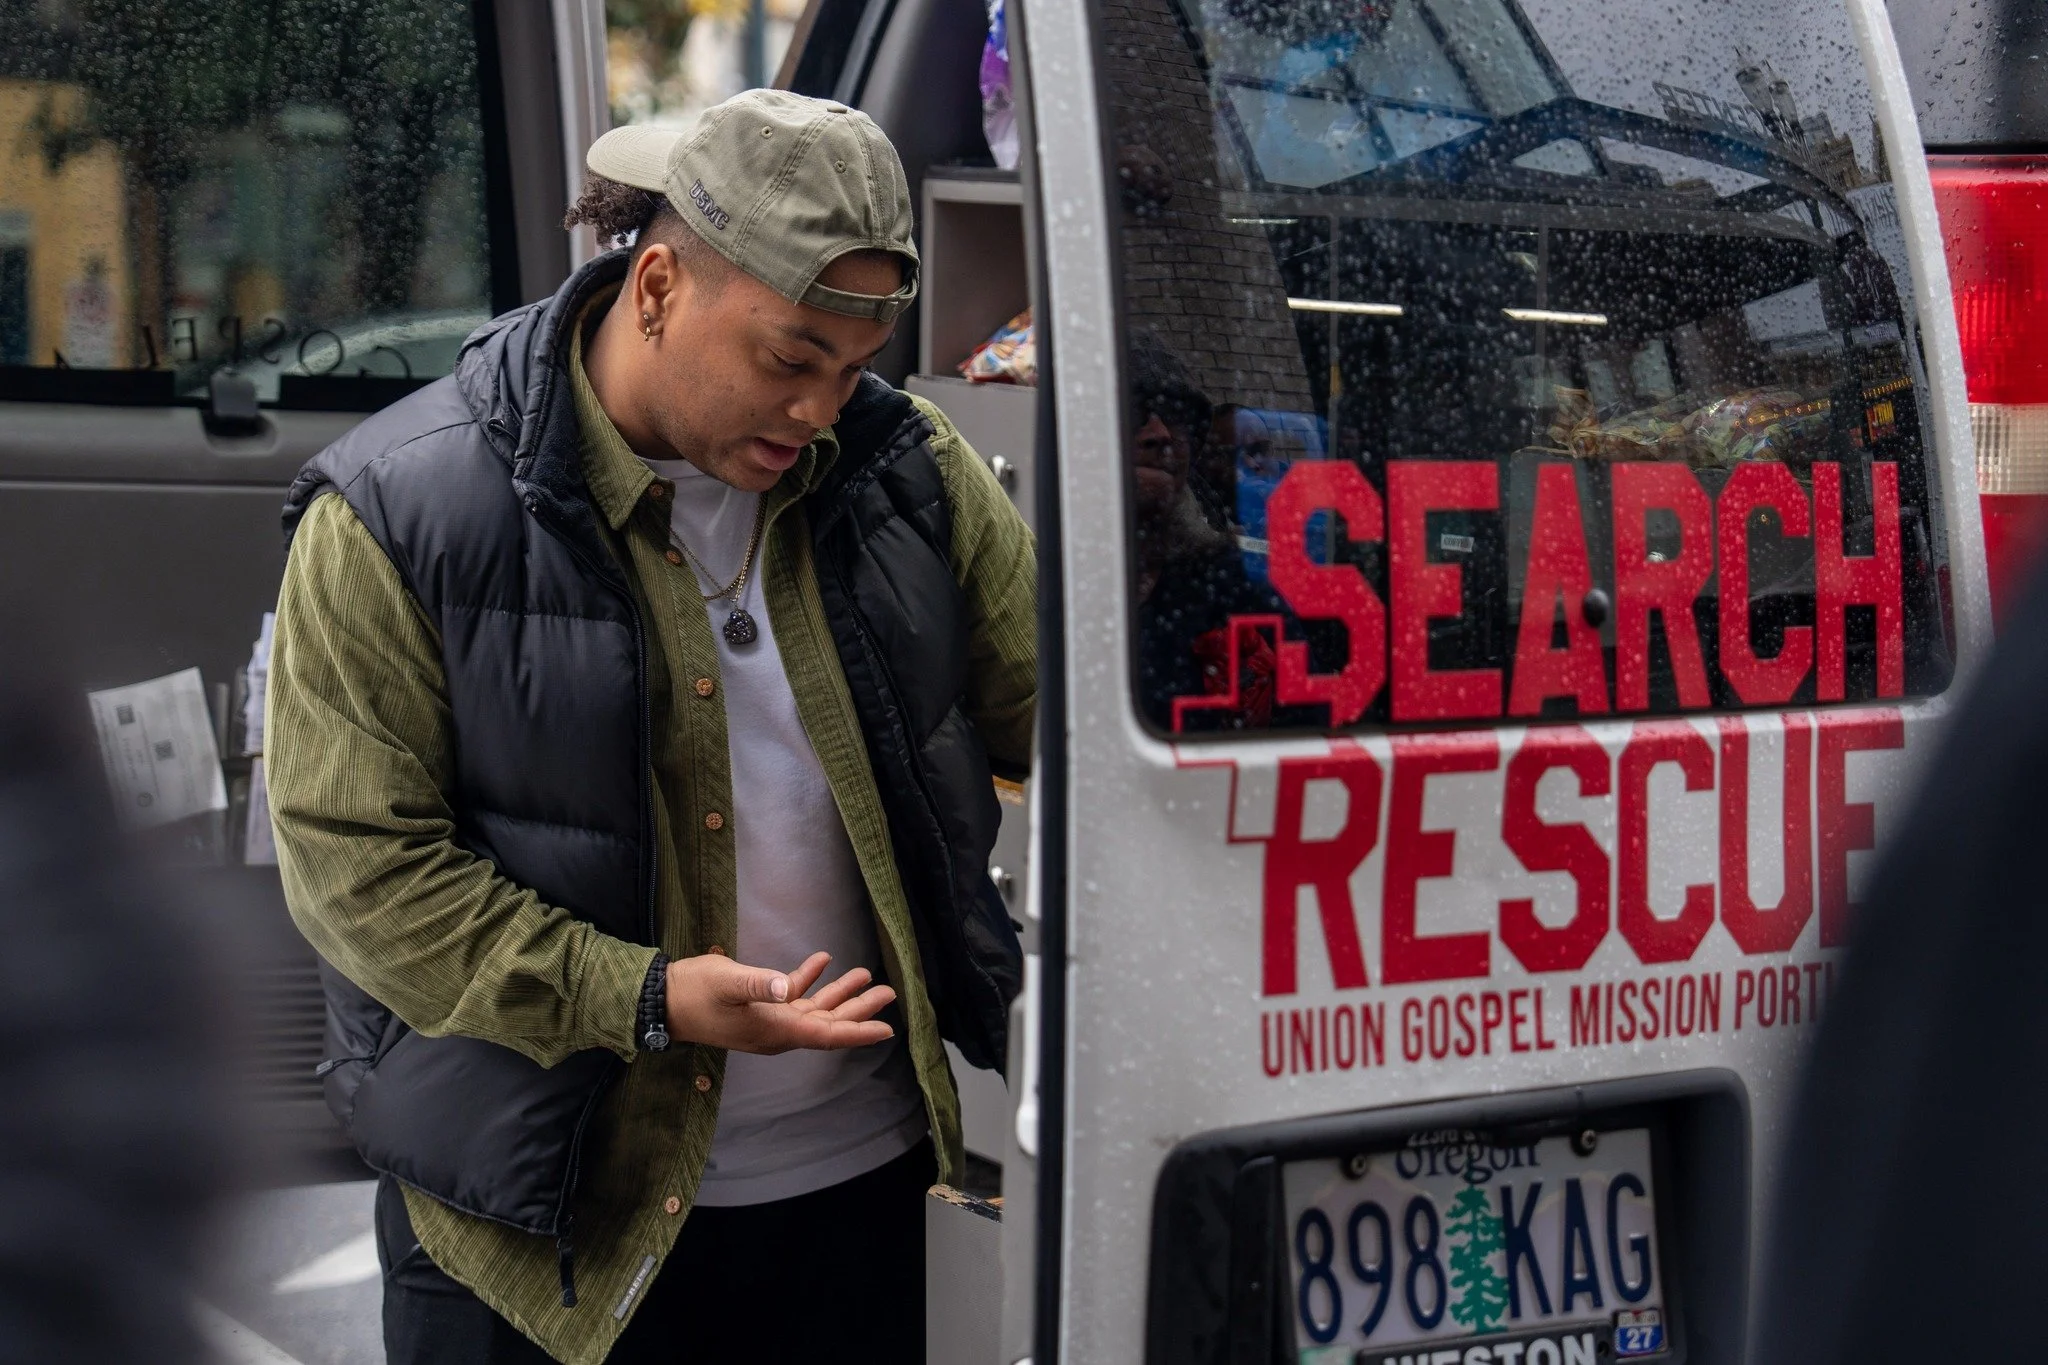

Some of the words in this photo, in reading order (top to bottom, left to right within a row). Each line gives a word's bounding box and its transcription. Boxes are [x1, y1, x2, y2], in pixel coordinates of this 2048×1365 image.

[689, 178, 731, 231] USMC
[1266, 459, 1906, 728] SEARCH
[1260, 706, 1906, 997] RESCUE
[1260, 1001, 1386, 1079] UNION
[1401, 987, 1555, 1064] GOSPEL
[1569, 970, 1722, 1048] MISSION
[1395, 1142, 1541, 1184] Oregon
[1296, 1194, 1448, 1344] 898
[1500, 1171, 1653, 1321] KAG
[1383, 1333, 1597, 1365] STON
[1626, 1327, 1654, 1350] 27
